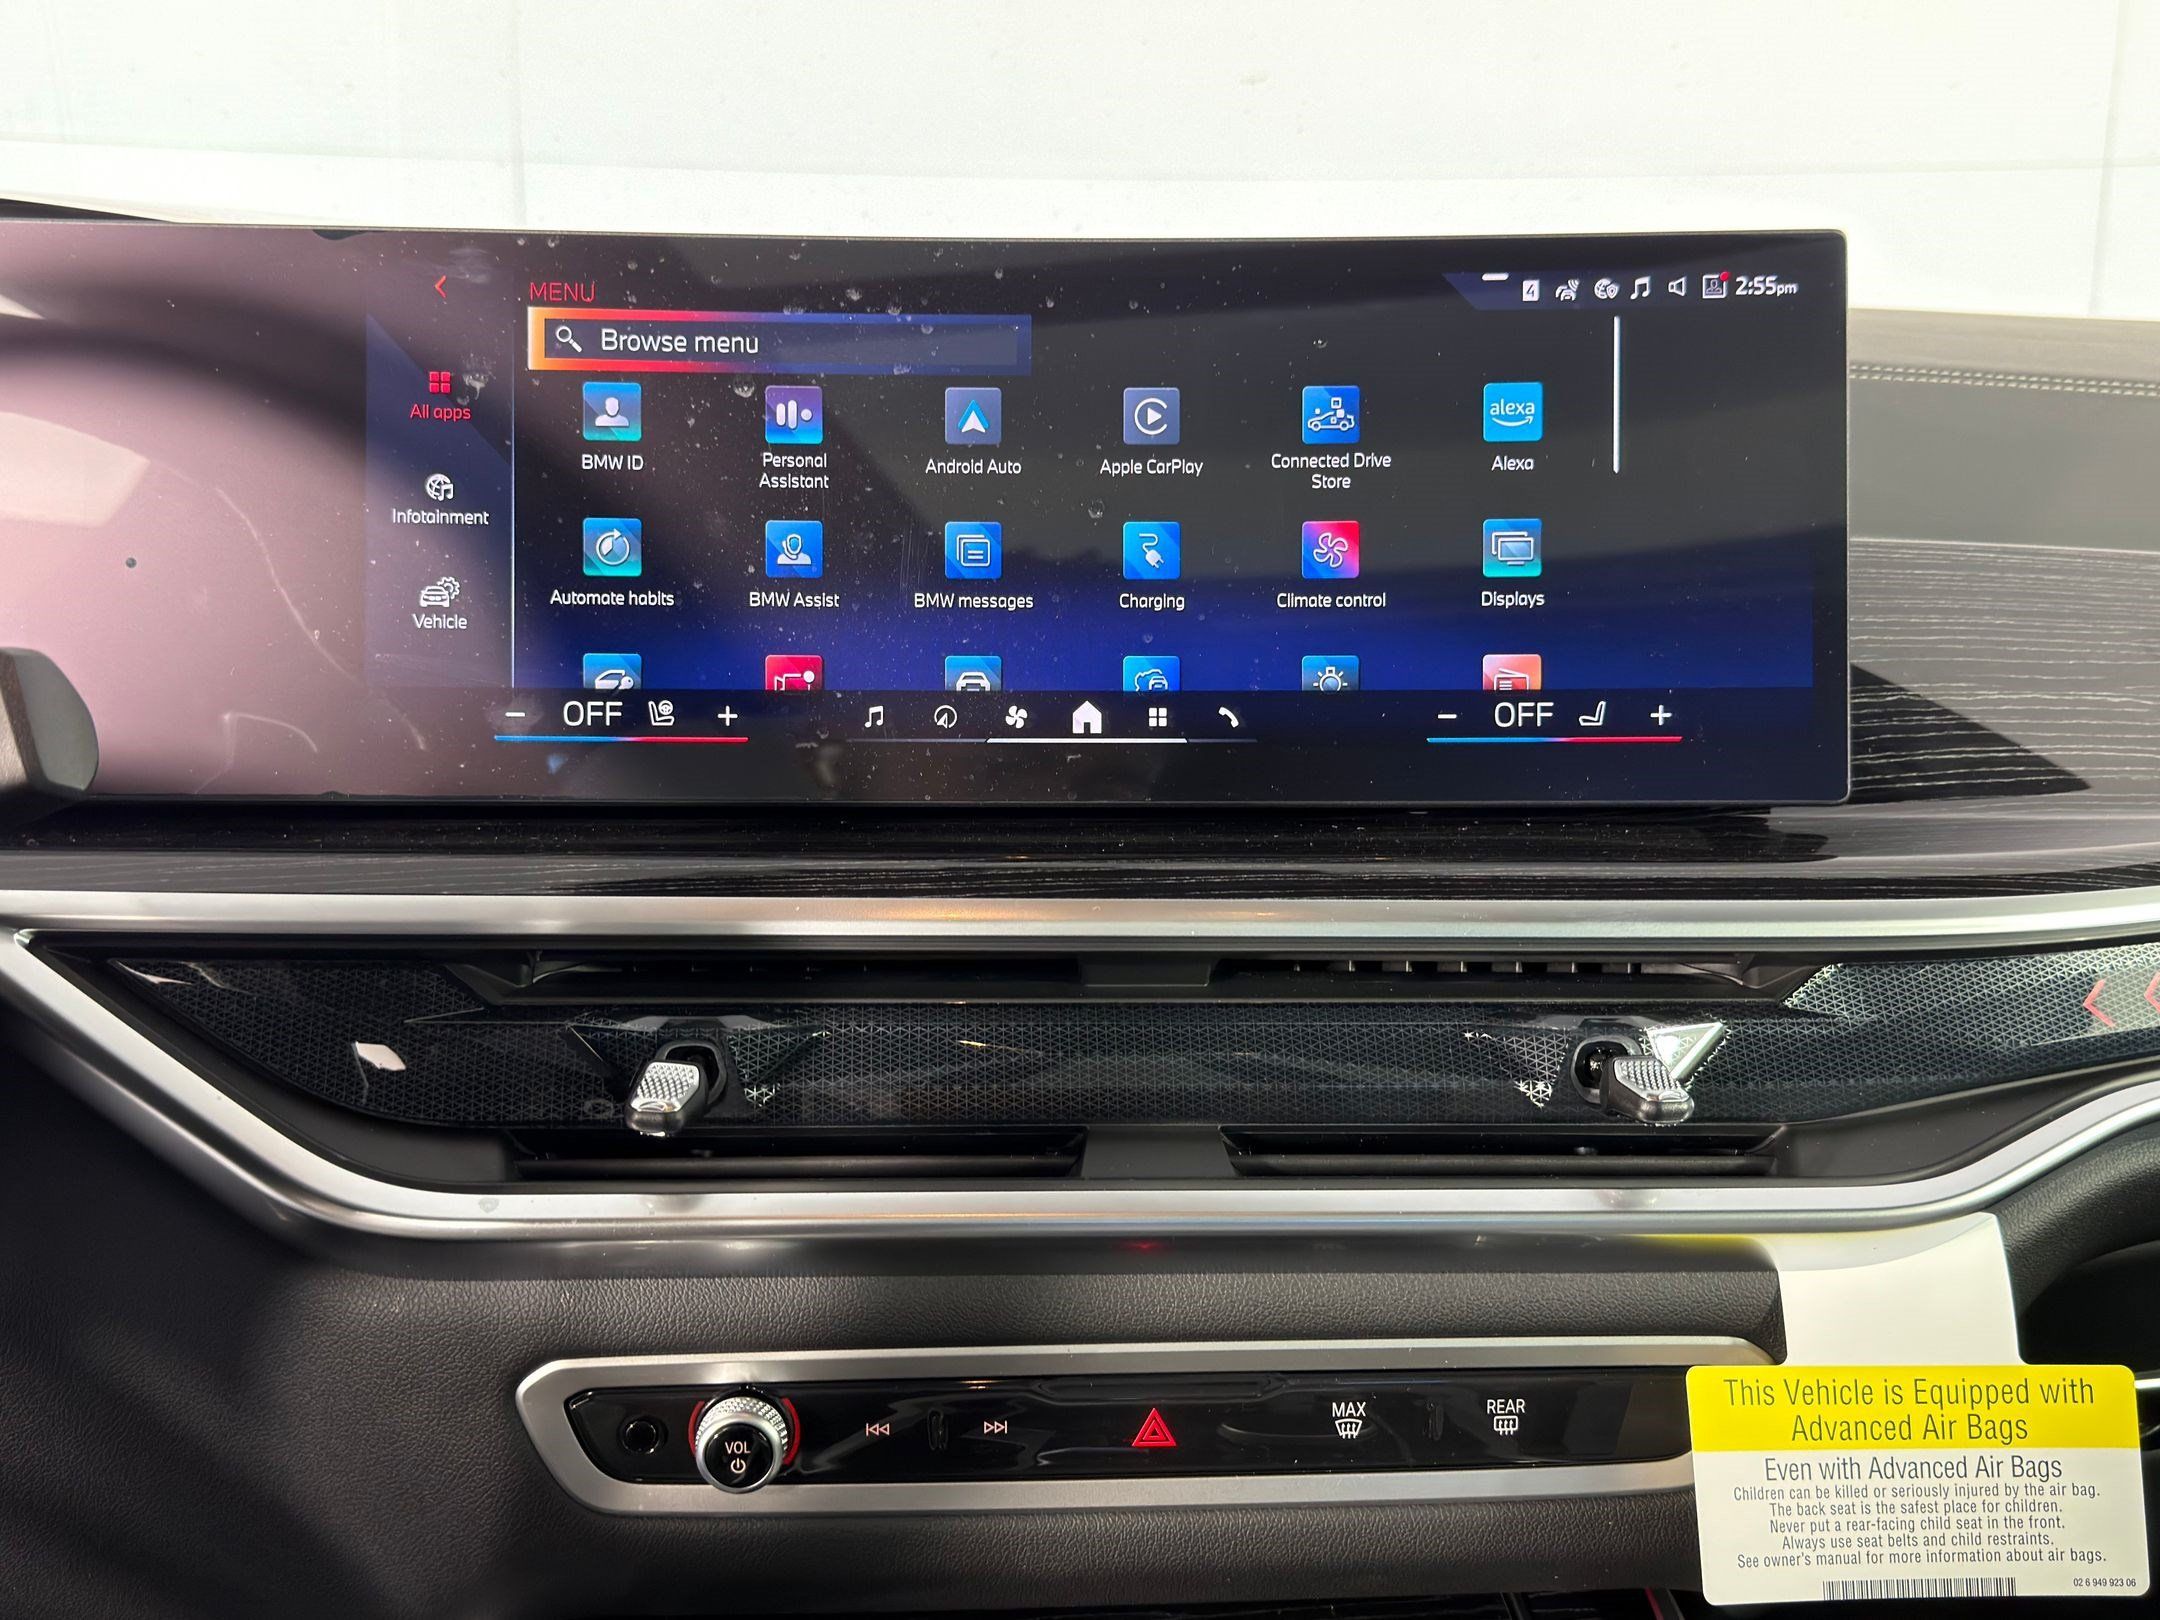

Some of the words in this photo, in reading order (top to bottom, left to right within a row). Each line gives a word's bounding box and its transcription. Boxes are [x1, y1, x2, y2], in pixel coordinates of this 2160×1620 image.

[529, 282, 596, 302] MENU
[1735, 276, 1798, 297] 2:55pm
[601, 329, 687, 354] Browse
[695, 333, 759, 354] menu
[410, 402, 428, 420] All
[431, 406, 472, 423] apps
[1489, 399, 1535, 416] alexa
[581, 453, 626, 471] BMW
[629, 453, 645, 471] ID
[762, 451, 828, 470] Personal
[925, 457, 983, 475] Android
[986, 457, 1022, 475] Auto
[1099, 458, 1144, 478] Apple
[1146, 458, 1204, 478] CarPlay
[1270, 453, 1349, 470] Connected
[1352, 452, 1392, 469] Drive
[1491, 456, 1534, 472] Alexa
[759, 472, 829, 490] Assistant
[1311, 473, 1352, 490] Store
[392, 507, 489, 526] Infotainment
[550, 589, 626, 607] Automate
[628, 589, 675, 607] habits
[749, 591, 793, 608] BMW
[795, 591, 840, 608] Assist
[914, 592, 955, 609] BMW
[957, 594, 1034, 612] messages
[1119, 592, 1186, 612] Charging
[1276, 591, 1333, 609] Climate
[1336, 591, 1387, 609] control
[1480, 591, 1545, 611] Displays
[413, 612, 468, 630] Vehicle
[562, 701, 623, 727] OFF
[1494, 702, 1554, 728] OFF
[1724, 1379, 1775, 1406] This
[1784, 1379, 1873, 1405] Vehicle
[1884, 1379, 1903, 1405] is
[1914, 1378, 2029, 1410] Equipped
[2040, 1378, 2094, 1404] with
[1332, 1402, 1366, 1417] MAX
[1487, 1399, 1525, 1414] REAR
[1792, 1414, 1912, 1441] Advanced
[1923, 1414, 1957, 1440] Air
[1968, 1414, 2028, 1445] Bags
[725, 1441, 751, 1454] VOL
[1765, 1458, 1812, 1481] Even
[1819, 1457, 1861, 1480] with
[1868, 1456, 1967, 1480] Advanced
[1975, 1455, 2003, 1478] Air
[2011, 1455, 2062, 1482] Bags
[1734, 1486, 1784, 1501] Children
[1789, 1488, 1811, 1499] can
[1815, 1486, 1830, 1499] be
[1835, 1485, 1868, 1498] killed
[1874, 1487, 1886, 1498] or
[1892, 1484, 1949, 1500] seriously
[1955, 1484, 1999, 1499] injured
[2005, 1484, 2019, 1499] by
[2025, 1484, 2045, 1496] the
[2050, 1483, 2066, 1495] air
[2072, 1483, 2100, 1498] bag.
[1769, 1502, 1792, 1516] The
[1797, 1502, 1825, 1516] back
[1830, 1502, 1856, 1515] seat
[1861, 1501, 1871, 1514] is
[1877, 1501, 1895, 1514] the
[1901, 1500, 1938, 1514] safest
[1944, 1500, 1977, 1516] place
[1982, 1500, 2000, 1512] for
[2005, 1500, 2062, 1512] children.
[1770, 1520, 1805, 1533] Never
[1810, 1519, 1830, 1535] put
[1835, 1521, 1841, 1532] a
[1847, 1517, 1915, 1532] rear-facing
[1921, 1517, 1951, 1530] child
[1956, 1516, 1982, 1529] seat
[1988, 1516, 1998, 1529] in
[2004, 1516, 2023, 1529] the
[2029, 1515, 2065, 1529] front.
[1782, 1536, 1825, 1551] Always
[1831, 1537, 1851, 1548] use
[1857, 1535, 1882, 1547] seat
[1888, 1534, 1918, 1547] belts
[1923, 1533, 1946, 1546] and
[1951, 1532, 1981, 1546] child
[1987, 1532, 2054, 1545] restraints.
[1738, 1554, 1758, 1568] See
[1764, 1554, 1811, 1567] owner's
[1816, 1552, 1861, 1565] manual
[1866, 1551, 1883, 1564] for
[1889, 1552, 1921, 1563] more
[1927, 1550, 2001, 1562] information
[2006, 1549, 2043, 1562] about
[2048, 1548, 2064, 1561] air
[2071, 1548, 2106, 1564] bags.
[2092, 1578, 2107, 1586] 949
[2109, 1578, 2124, 1586] 923
